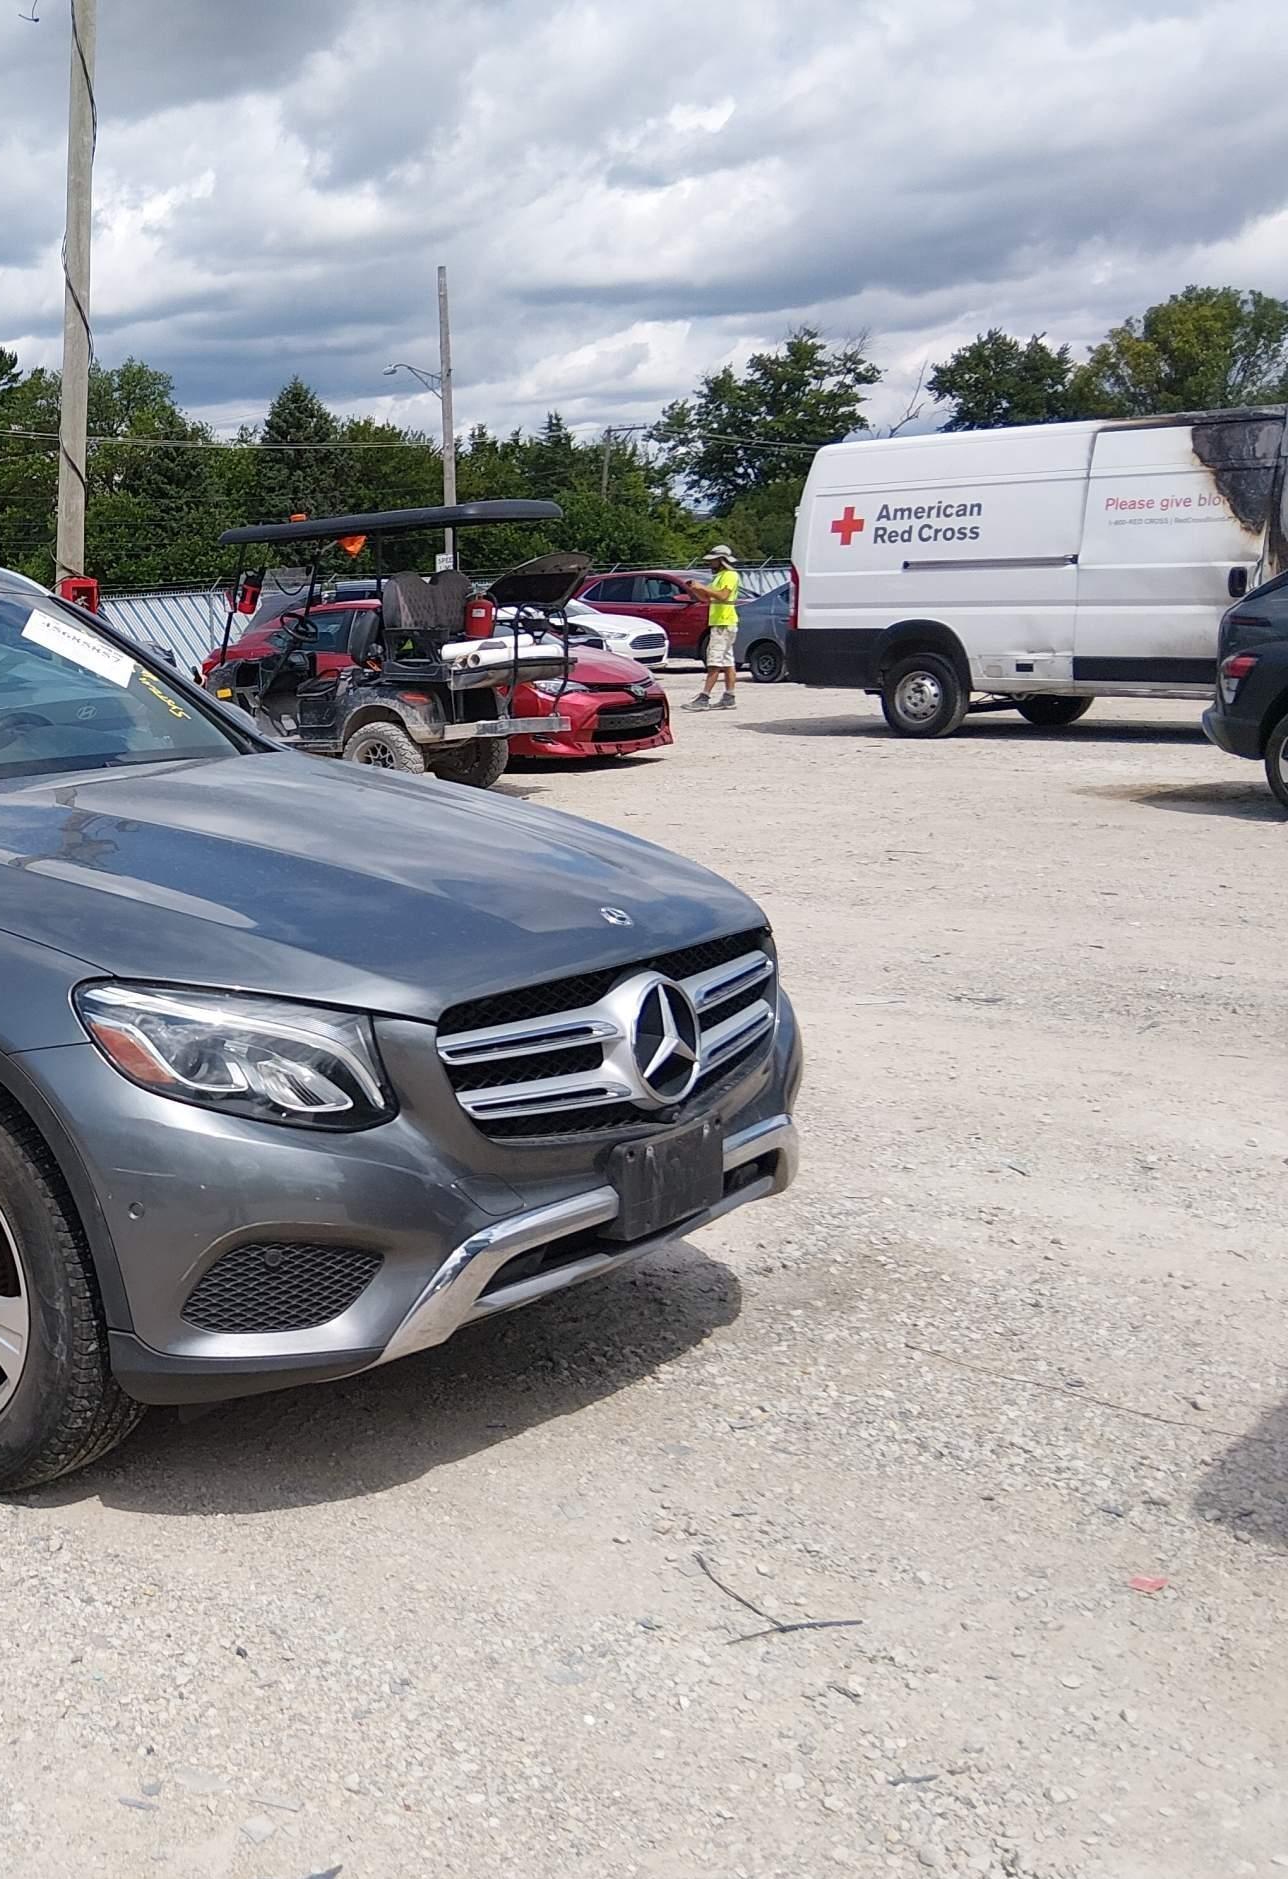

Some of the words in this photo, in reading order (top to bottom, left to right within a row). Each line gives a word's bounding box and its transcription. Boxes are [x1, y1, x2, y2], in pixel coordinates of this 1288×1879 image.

[875, 500, 983, 522] American
[1105, 497, 1155, 511] Please
[1159, 495, 1192, 511] give
[1197, 492, 1225, 507] blo
[873, 526, 913, 544] Red
[917, 524, 980, 543] Cross
